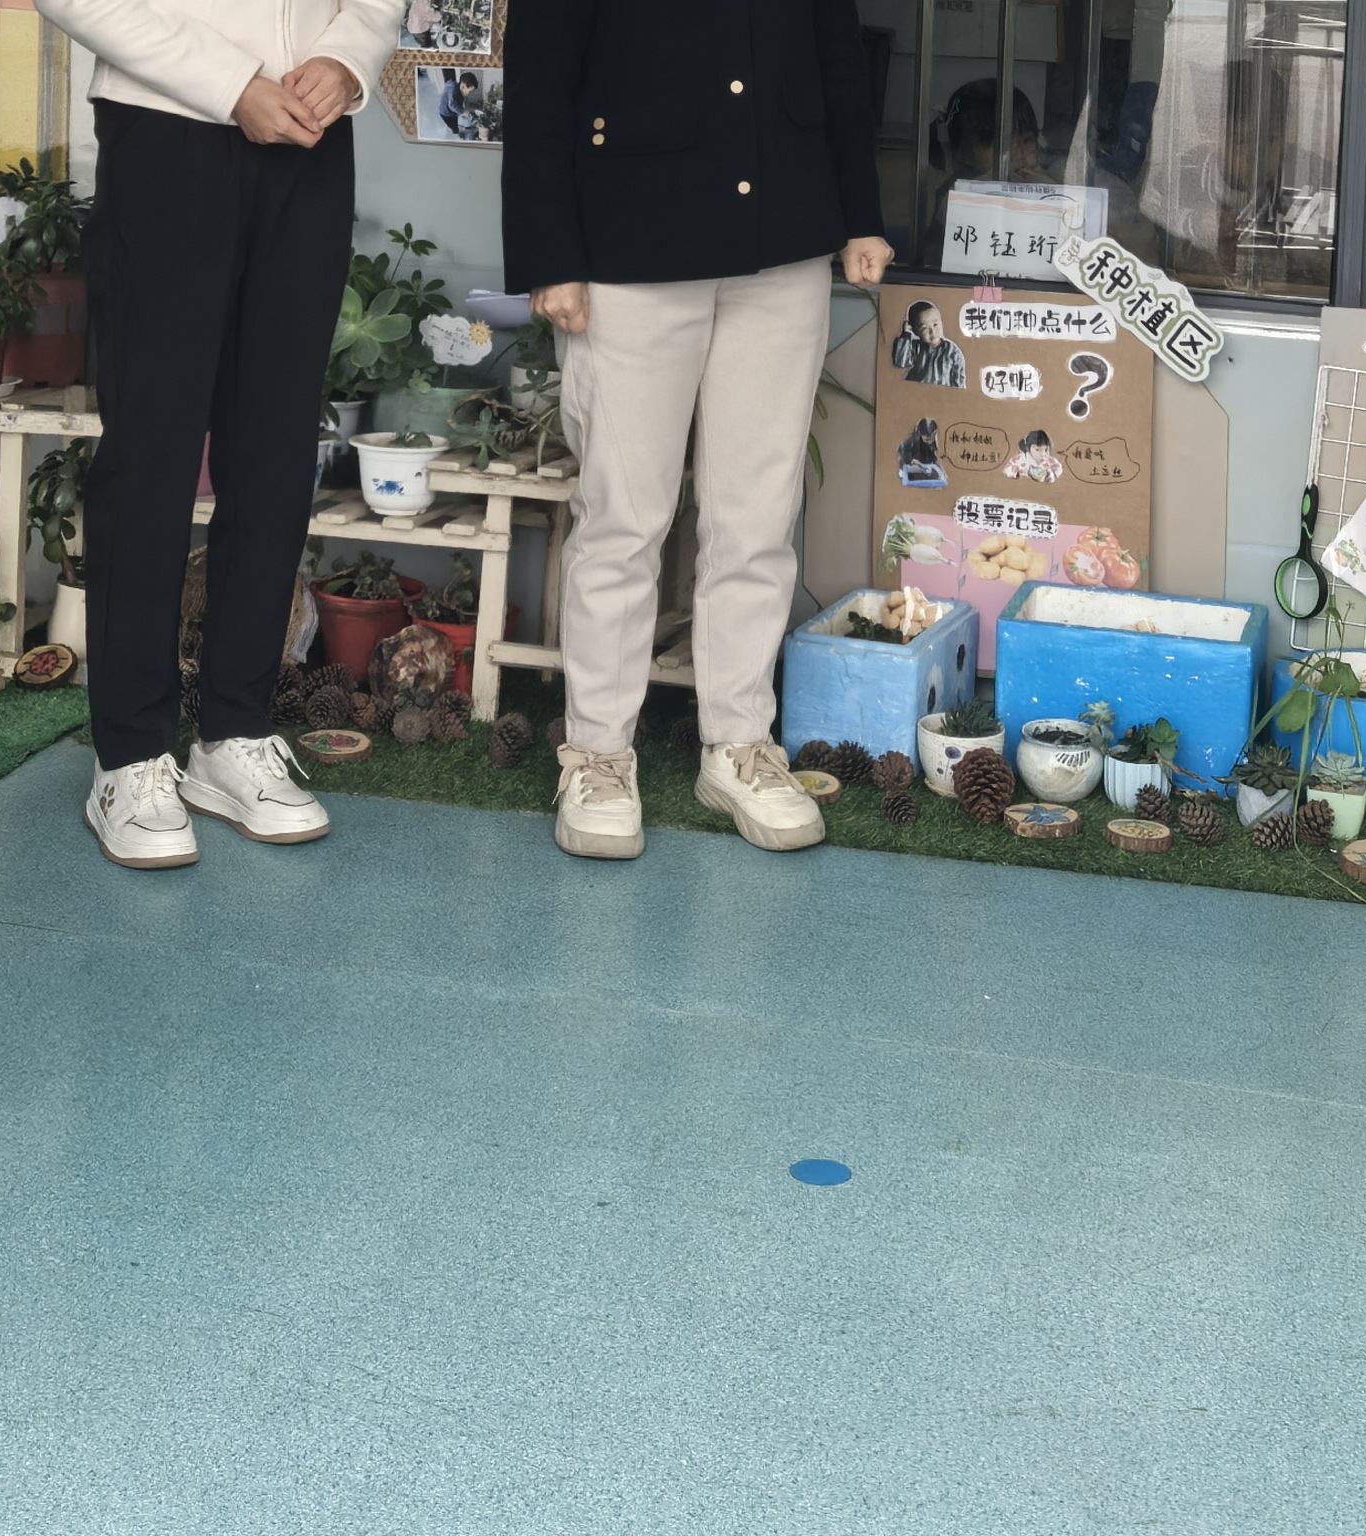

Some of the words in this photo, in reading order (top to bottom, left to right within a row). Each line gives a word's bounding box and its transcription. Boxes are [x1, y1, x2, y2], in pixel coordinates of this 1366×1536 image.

[964, 307, 1112, 336] 我们种点什么
[1086, 250, 1214, 370] 种植区
[985, 369, 1034, 394] 好呢
[957, 500, 1054, 535] 投票记录
